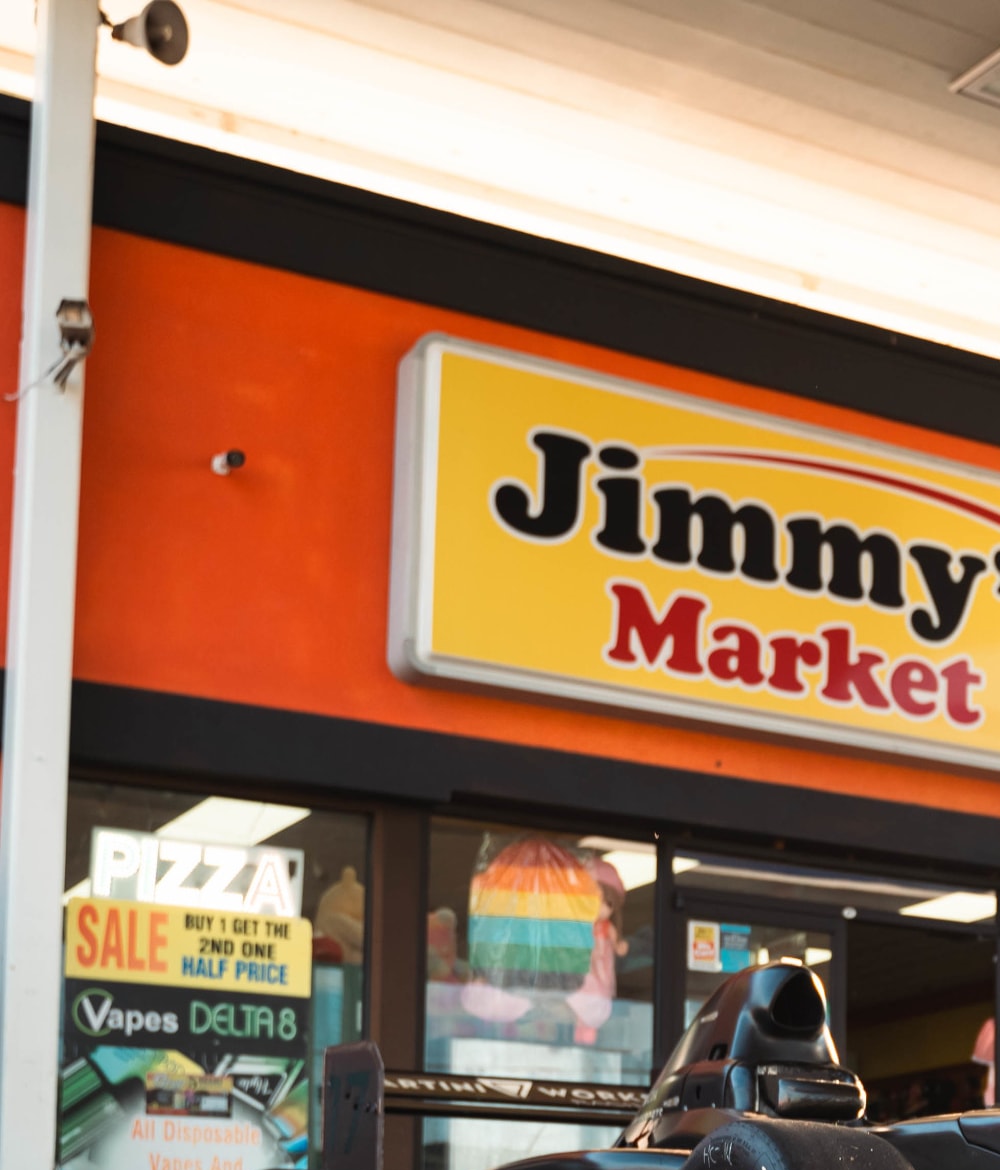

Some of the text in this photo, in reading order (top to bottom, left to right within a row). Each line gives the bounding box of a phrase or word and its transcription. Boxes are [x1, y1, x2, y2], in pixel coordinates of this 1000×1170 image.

[607, 584, 983, 725] Market
[93, 831, 295, 918] PIZZA
[76, 904, 169, 973] SALE
[184, 914, 291, 939] BUY 1 GET THE
[199, 938, 276, 960] 2ND ONE
[181, 955, 288, 985] HALF PRICE
[79, 994, 298, 1041] Vapes DELTA 8
[384, 1077, 487, 1094] ARTINI
[131, 1118, 261, 1146] All Disposable
